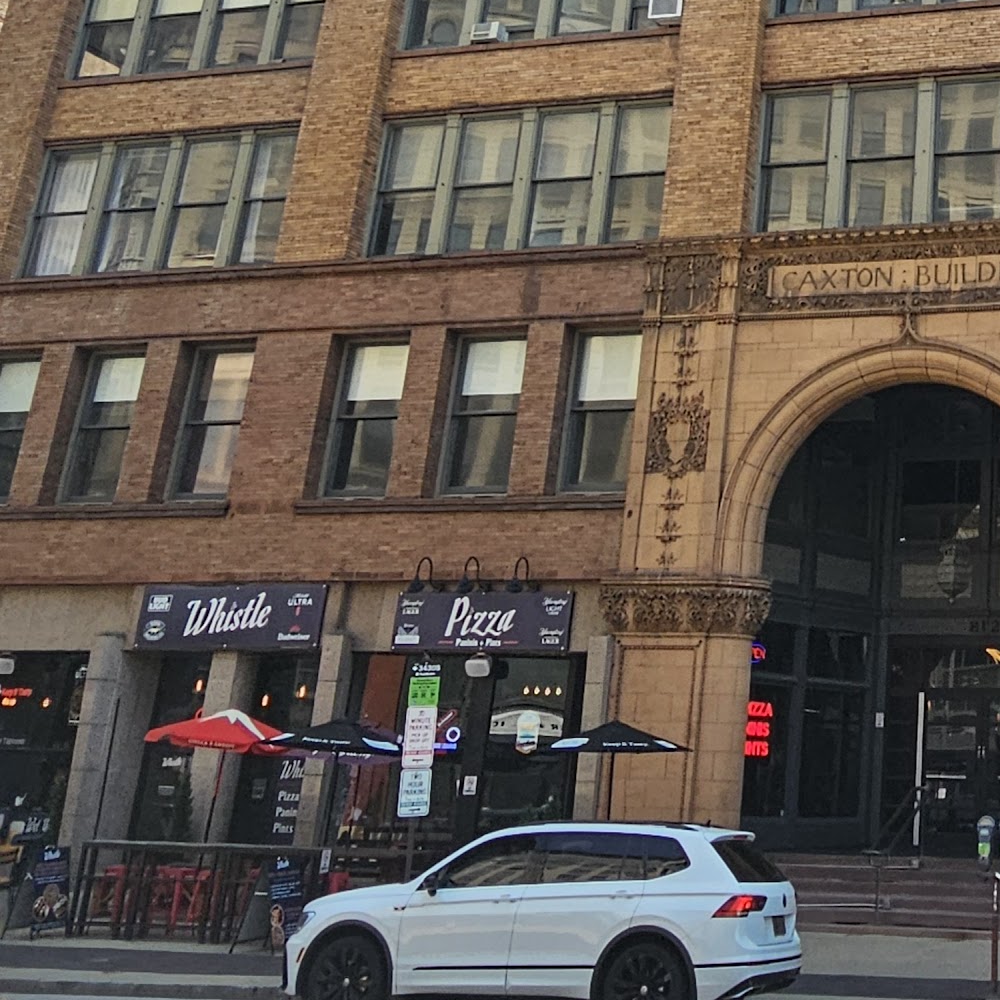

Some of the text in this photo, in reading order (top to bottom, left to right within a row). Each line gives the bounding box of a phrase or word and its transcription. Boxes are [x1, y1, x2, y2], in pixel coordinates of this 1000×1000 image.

[782, 266, 893, 291] CAXTON
[183, 592, 272, 637] Whistle
[287, 598, 313, 606] ULTRA
[444, 596, 516, 637] Pizza
[278, 790, 300, 801] Pizza
